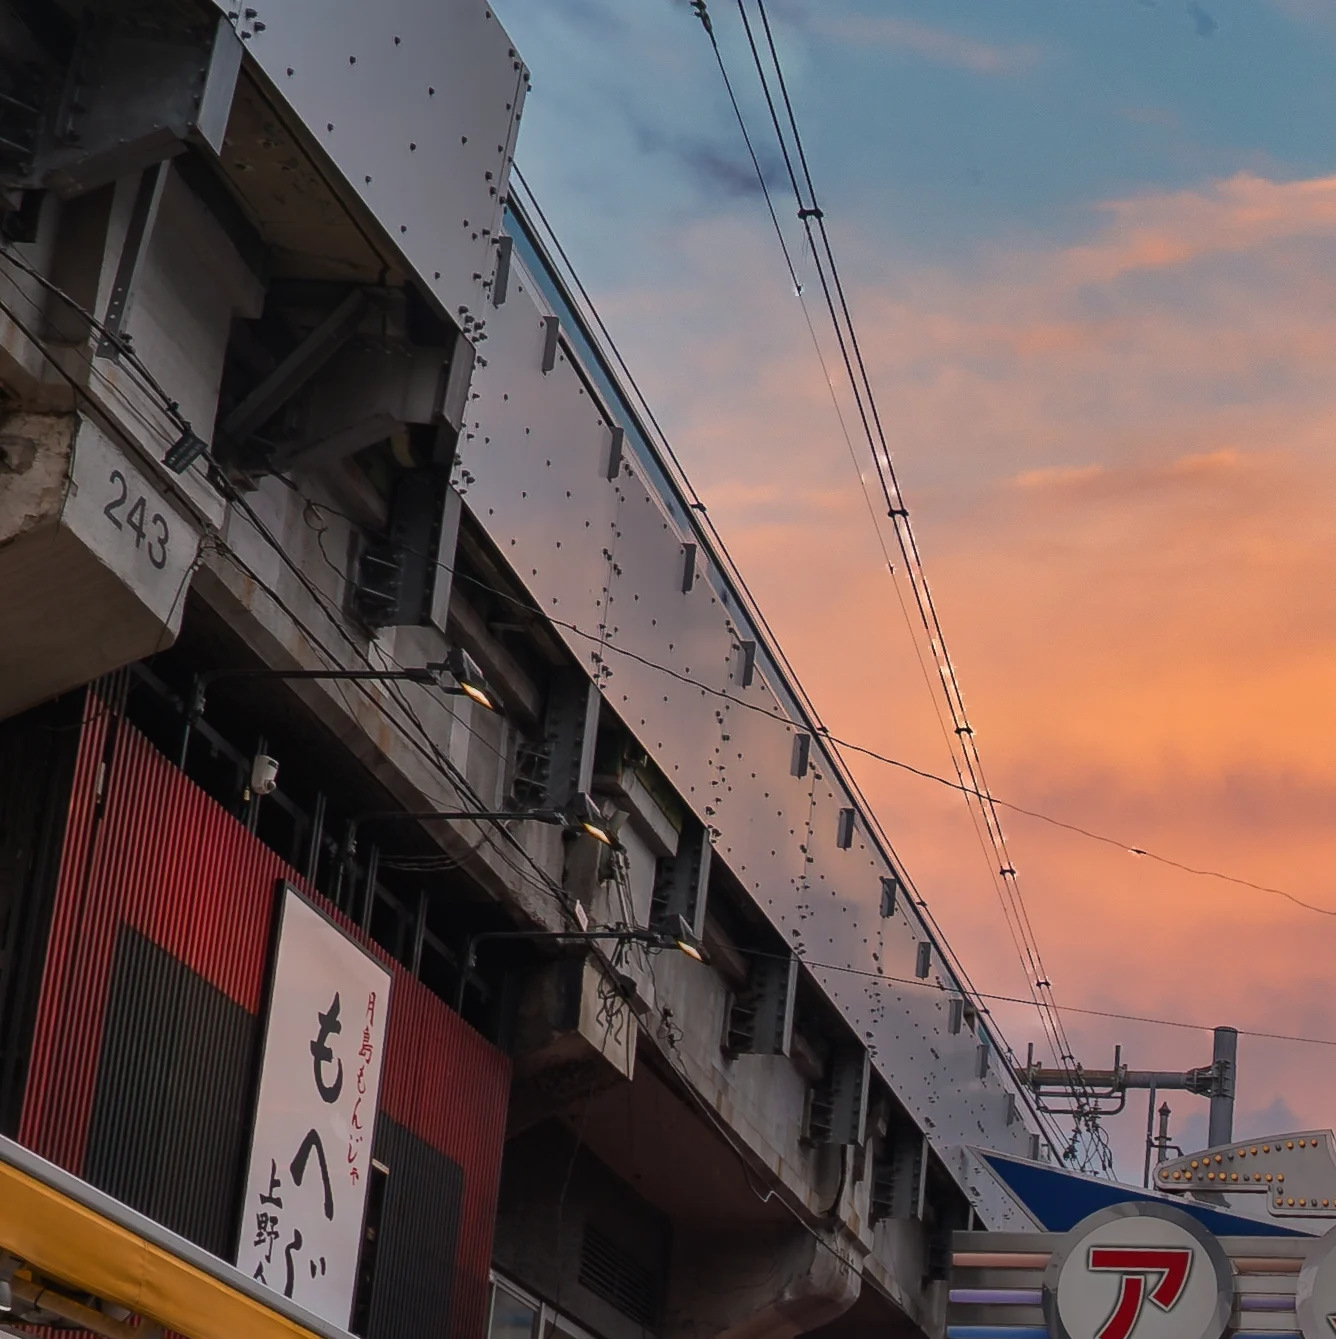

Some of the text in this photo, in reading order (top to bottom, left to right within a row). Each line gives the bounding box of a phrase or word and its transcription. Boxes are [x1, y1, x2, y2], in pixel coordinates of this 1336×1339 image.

[103, 469, 170, 570] 243
[285, 991, 344, 1300] もへじ
